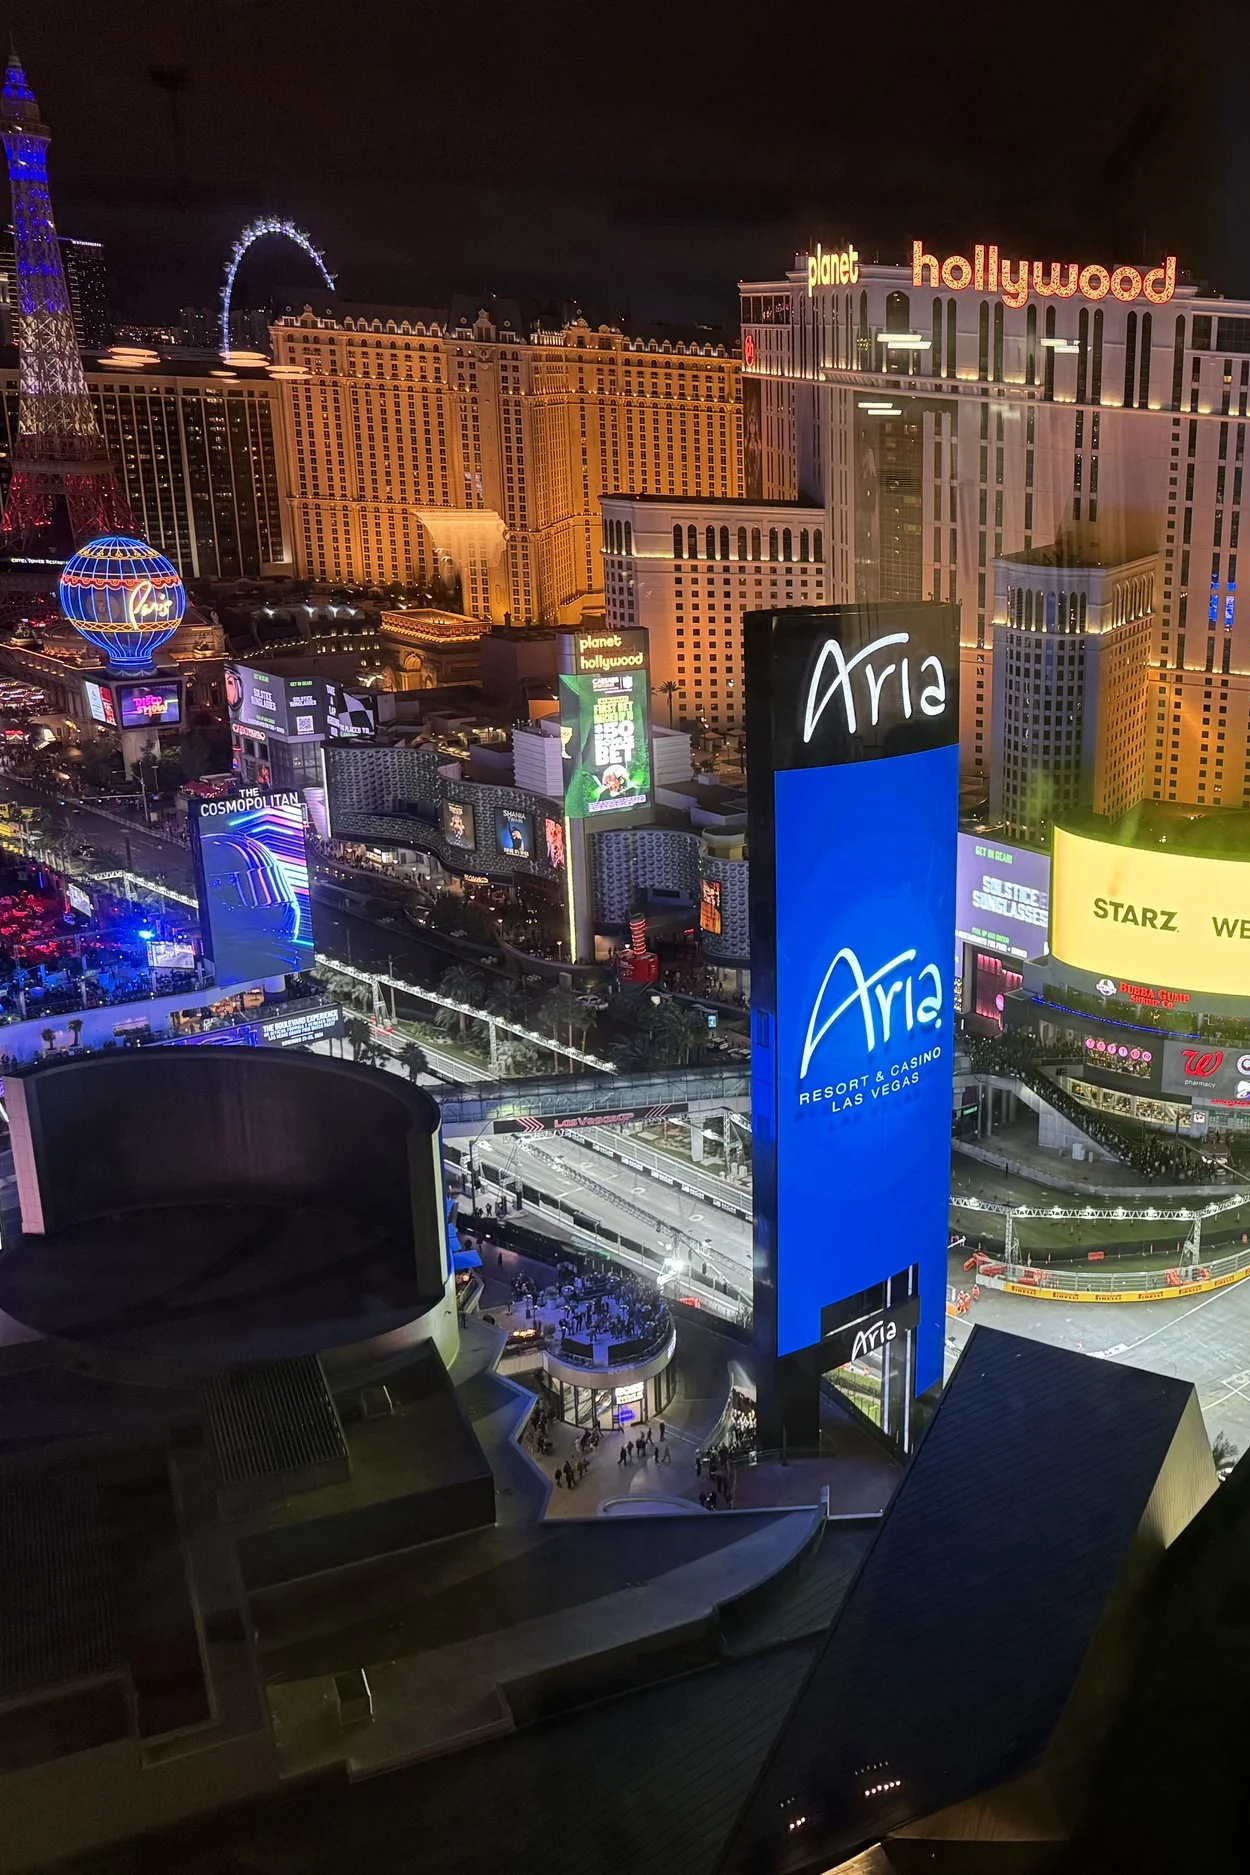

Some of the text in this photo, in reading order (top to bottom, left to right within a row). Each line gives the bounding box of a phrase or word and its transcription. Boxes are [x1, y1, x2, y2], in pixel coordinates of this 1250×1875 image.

[808, 241, 1177, 308] planet hollywood
[129, 581, 173, 631] Paris
[580, 635, 622, 653] planet
[580, 652, 644, 671] hollywood
[803, 632, 947, 743] Aria
[595, 747, 633, 766] BET
[239, 787, 260, 798] THE
[200, 791, 299, 817] COSMOPOLITAN
[502, 809, 527, 820] SHANIA
[975, 845, 987, 858] GET
[982, 875, 1040, 907] SOLSTICE
[972, 890, 1049, 928] SUNGLASSES
[1092, 897, 1180, 933] STARZ
[1119, 981, 1192, 1005] BUBBA GUMP
[1130, 994, 1160, 1007] SHRIMP
[306, 1009, 338, 1022] EXPERIENCE
[799, 947, 943, 1079] Aria
[800, 1045, 942, 1106] RESORT & CASINO
[1184, 1078, 1216, 1089] pharmacy
[831, 1071, 920, 1113] LAS VEGAS
[1011, 1285, 1037, 1295] PIRELLI
[1179, 1285, 1202, 1296] PIRELLI
[1214, 1275, 1235, 1287] PIRELLI
[1052, 1291, 1079, 1300] PIRELLI
[1138, 1291, 1164, 1300] PIRELLI
[851, 1320, 897, 1362] Aria
